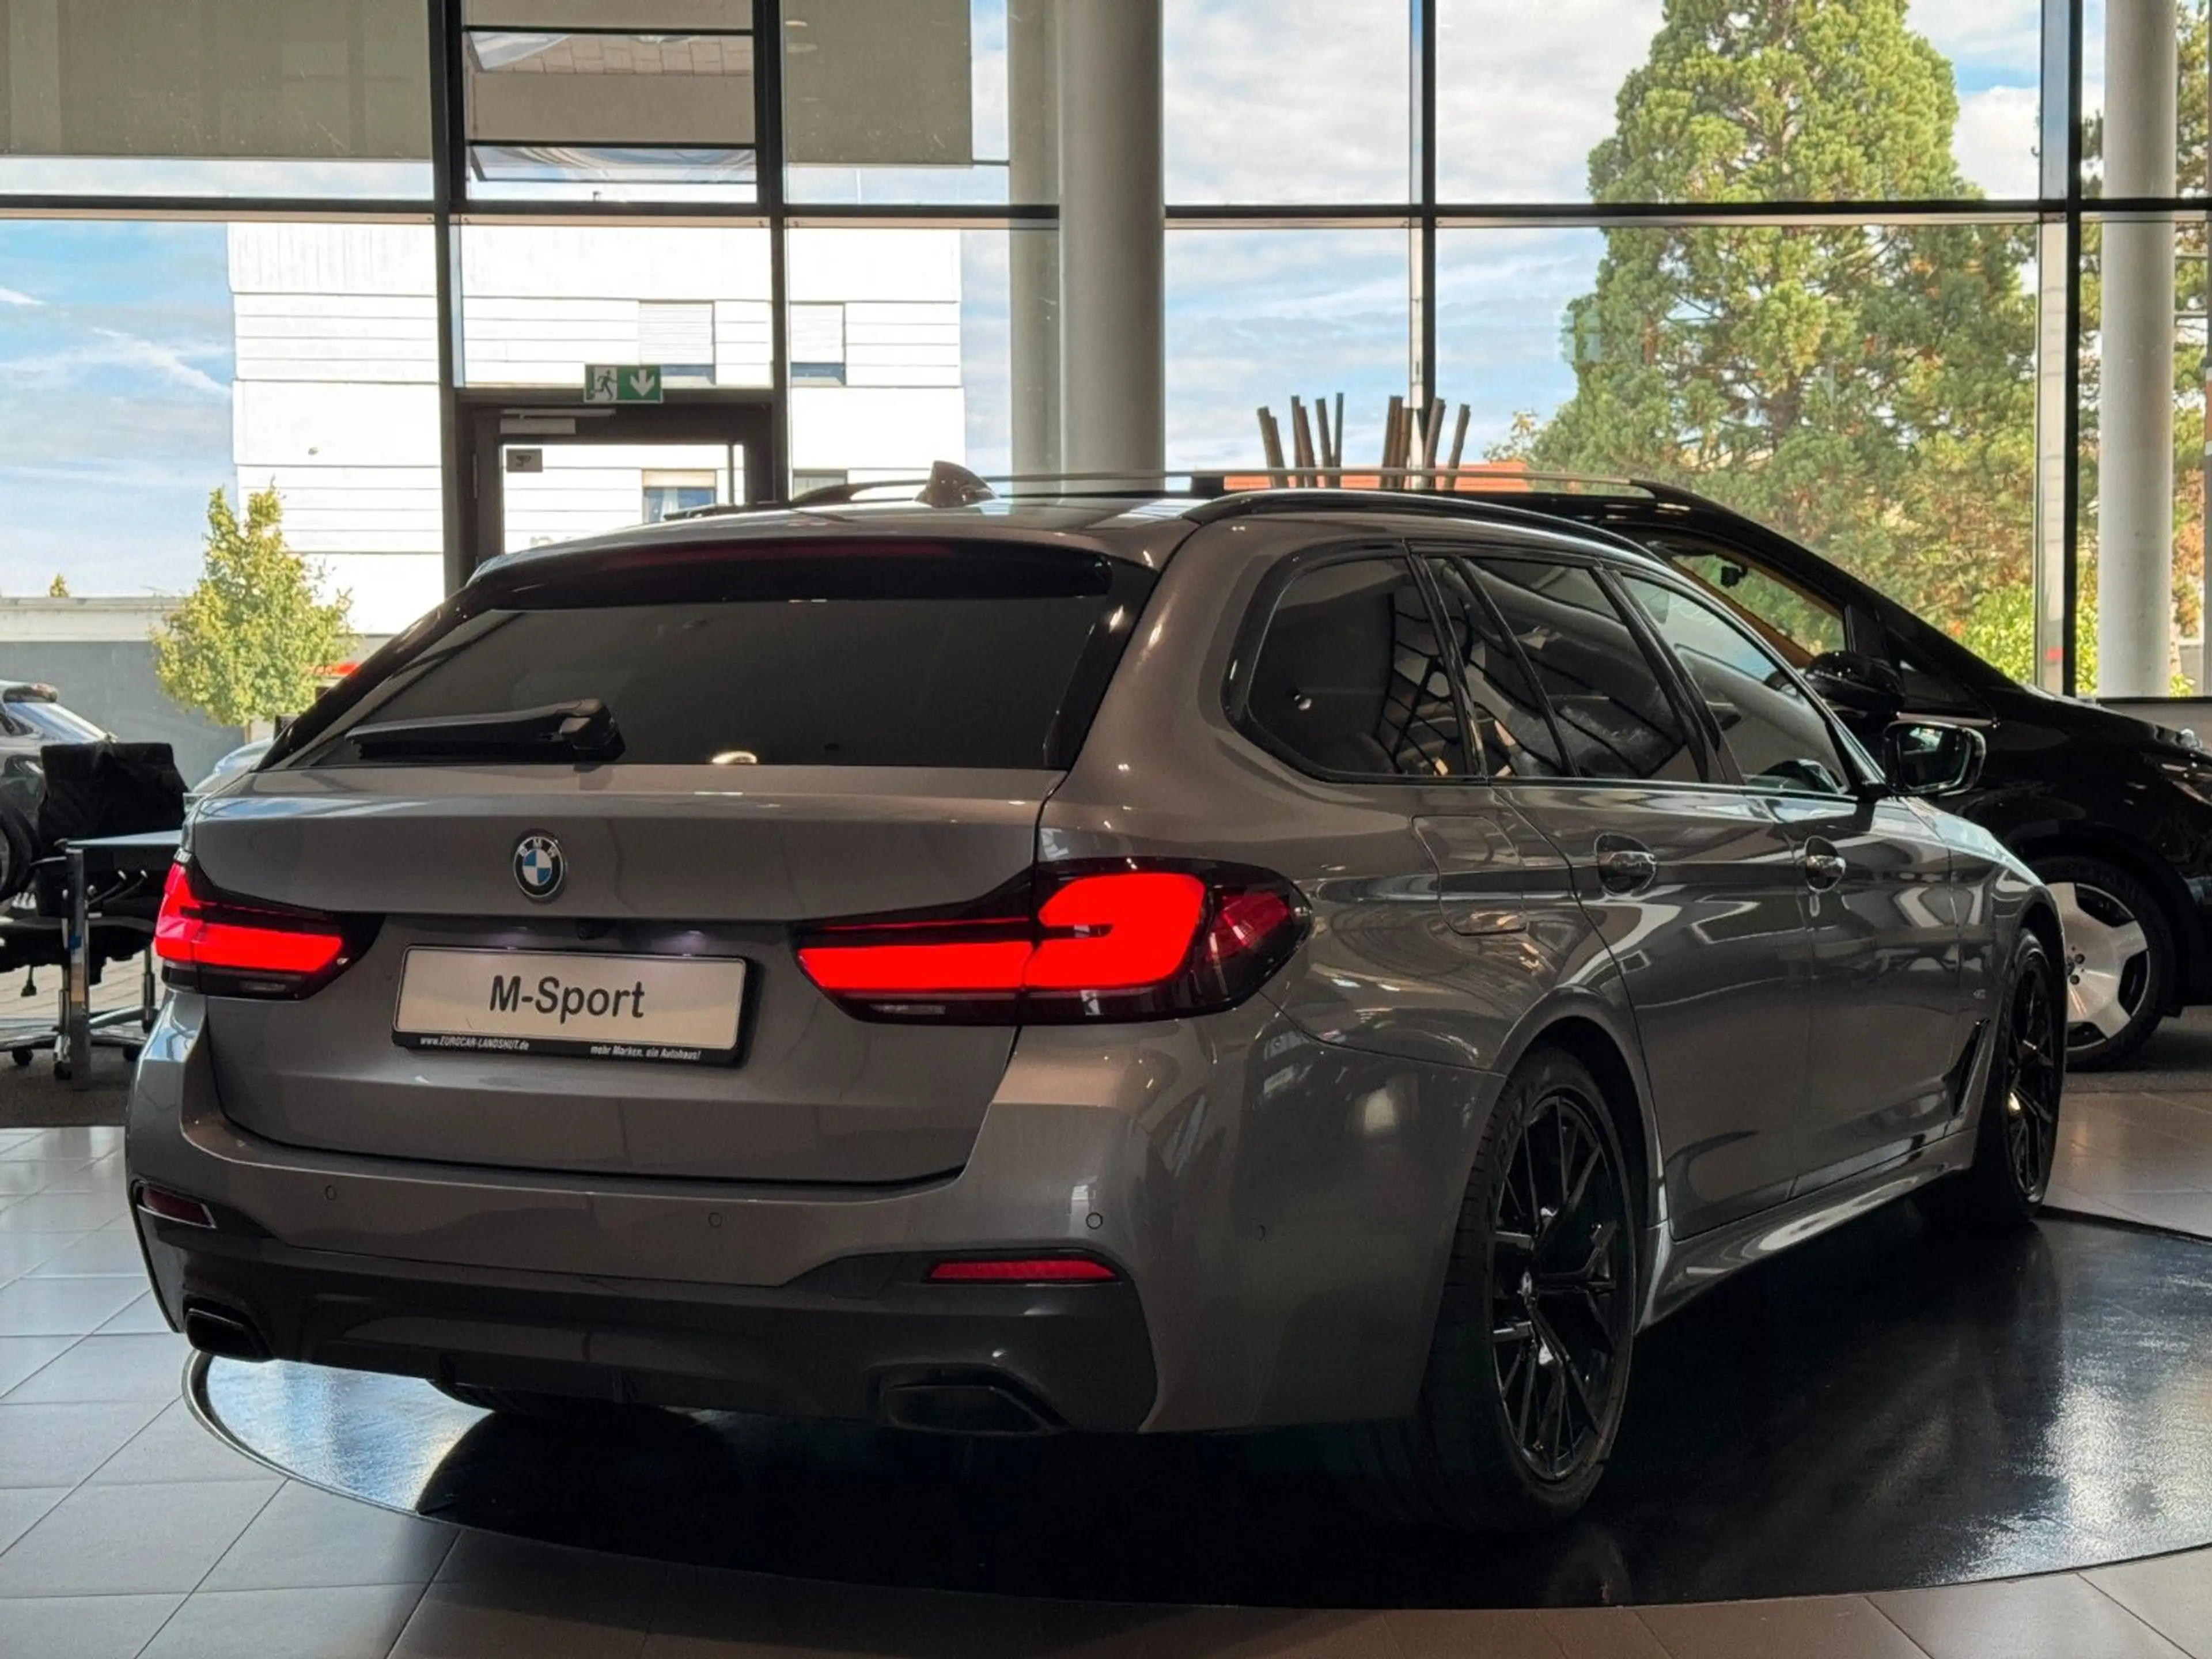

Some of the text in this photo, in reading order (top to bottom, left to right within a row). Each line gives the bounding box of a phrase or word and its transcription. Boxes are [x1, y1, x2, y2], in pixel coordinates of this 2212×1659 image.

[518, 837, 559, 858] BMW
[490, 975, 645, 1024] M-Sport
[590, 1045, 611, 1055] mehr
[646, 1047, 659, 1058] ein
[660, 1047, 701, 1060] Autohaus!
